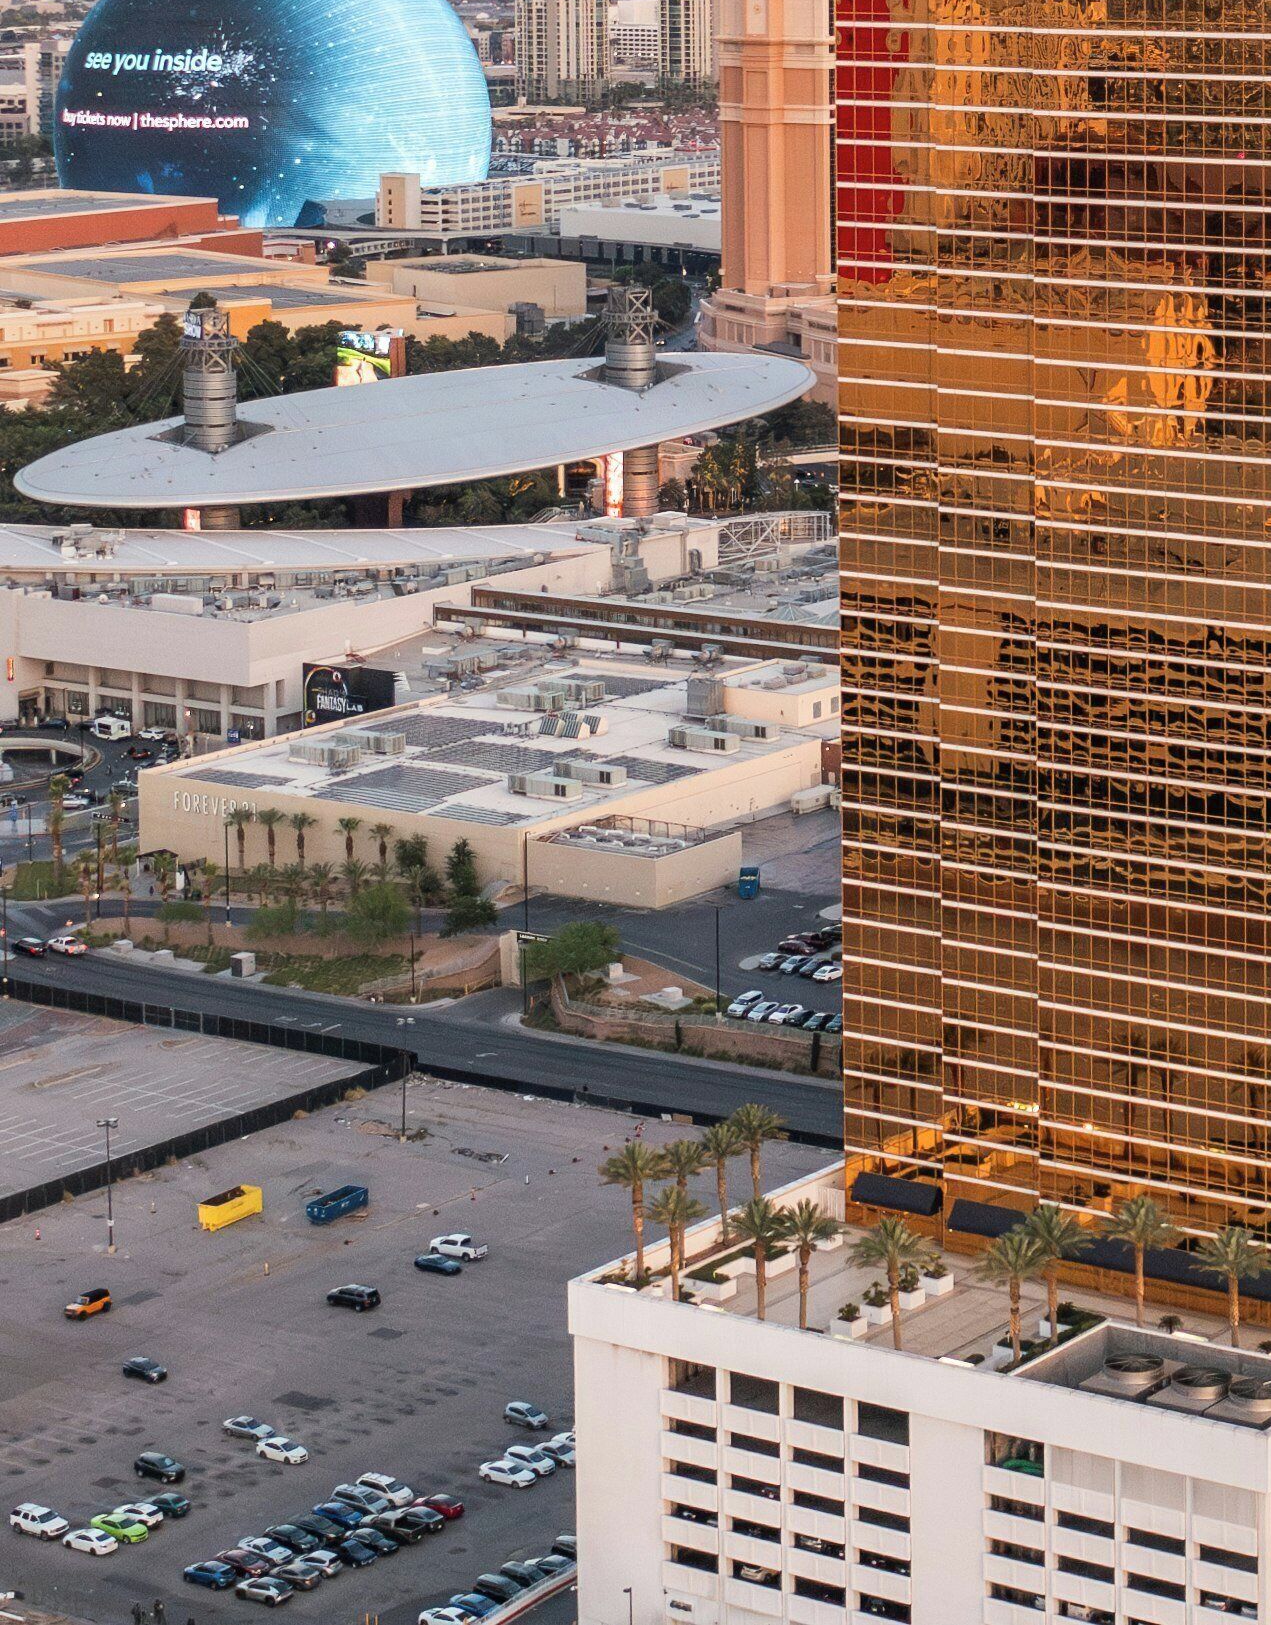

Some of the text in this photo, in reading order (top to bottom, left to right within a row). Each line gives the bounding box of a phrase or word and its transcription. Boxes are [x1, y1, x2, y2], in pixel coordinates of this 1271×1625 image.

[84, 49, 223, 75] see you inside
[75, 110, 105, 126] tickets
[107, 114, 132, 127] now
[140, 114, 249, 131] thesphere.com
[316, 694, 364, 714] FANTASY LAB
[174, 790, 237, 817] FOREVER
